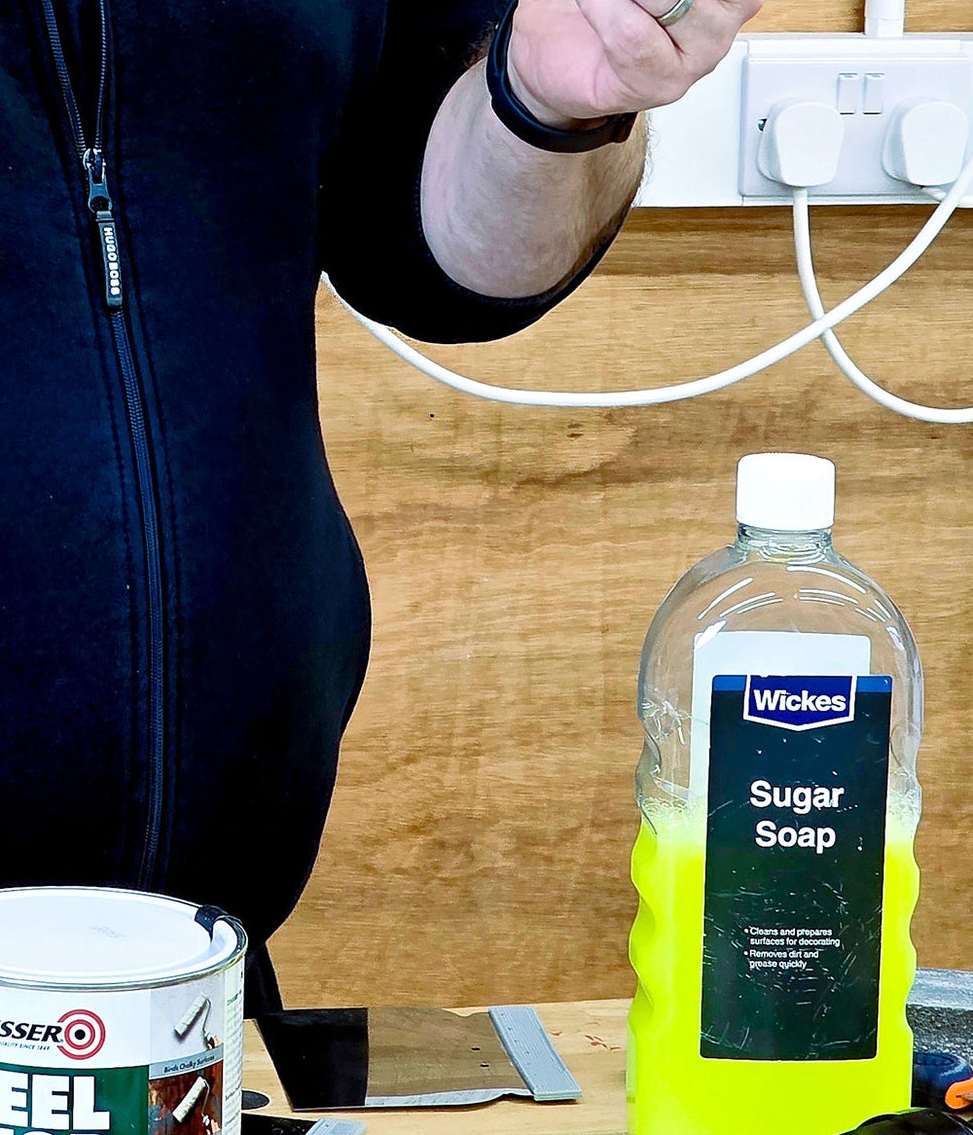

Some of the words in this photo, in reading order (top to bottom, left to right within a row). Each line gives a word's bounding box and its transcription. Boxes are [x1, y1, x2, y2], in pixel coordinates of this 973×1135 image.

[103, 227, 118, 261] HUGO
[753, 689, 847, 712] Wickes
[749, 779, 845, 815] Sugar
[755, 820, 837, 854] Soap
[749, 927, 778, 936] Cleans
[779, 928, 796, 936] and
[796, 929, 833, 937] prepares
[749, 937, 785, 946] surfaces
[786, 937, 798, 946] for
[798, 938, 840, 948] decorating
[749, 949, 787, 958] Removes
[788, 950, 802, 958] dirt
[803, 950, 819, 958] and
[749, 960, 778, 969] grease
[778, 960, 807, 970] quickly
